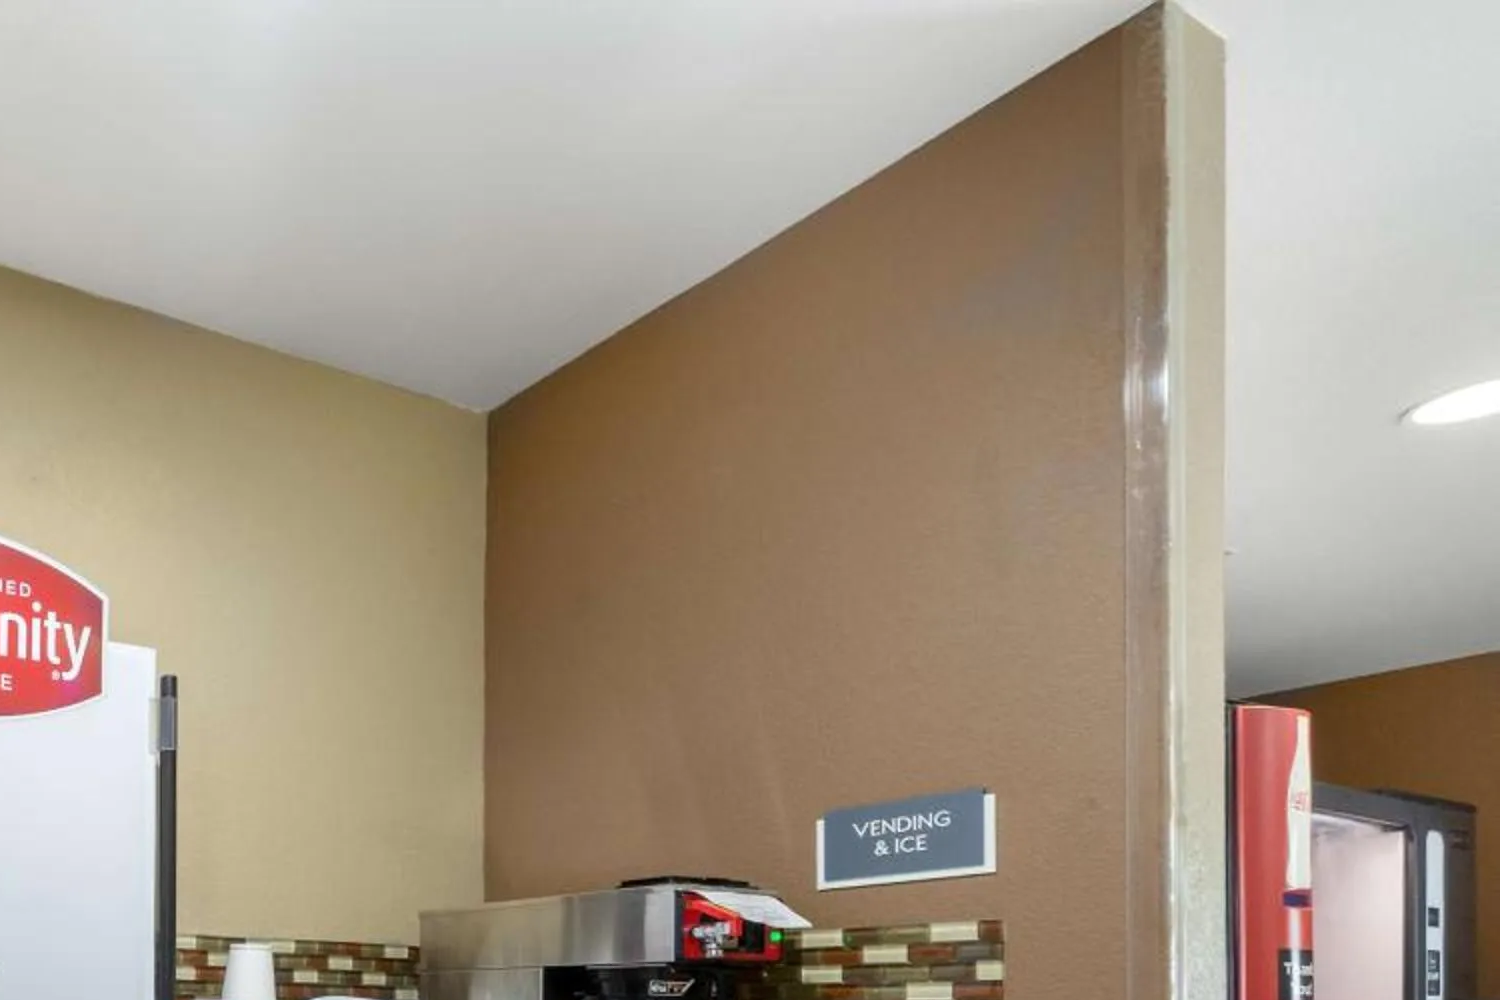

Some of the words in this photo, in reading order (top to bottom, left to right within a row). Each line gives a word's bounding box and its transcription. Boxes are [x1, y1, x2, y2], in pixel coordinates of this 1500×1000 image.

[852, 810, 951, 838] VENDING
[874, 840, 889, 856] &
[895, 834, 928, 854] ICE
